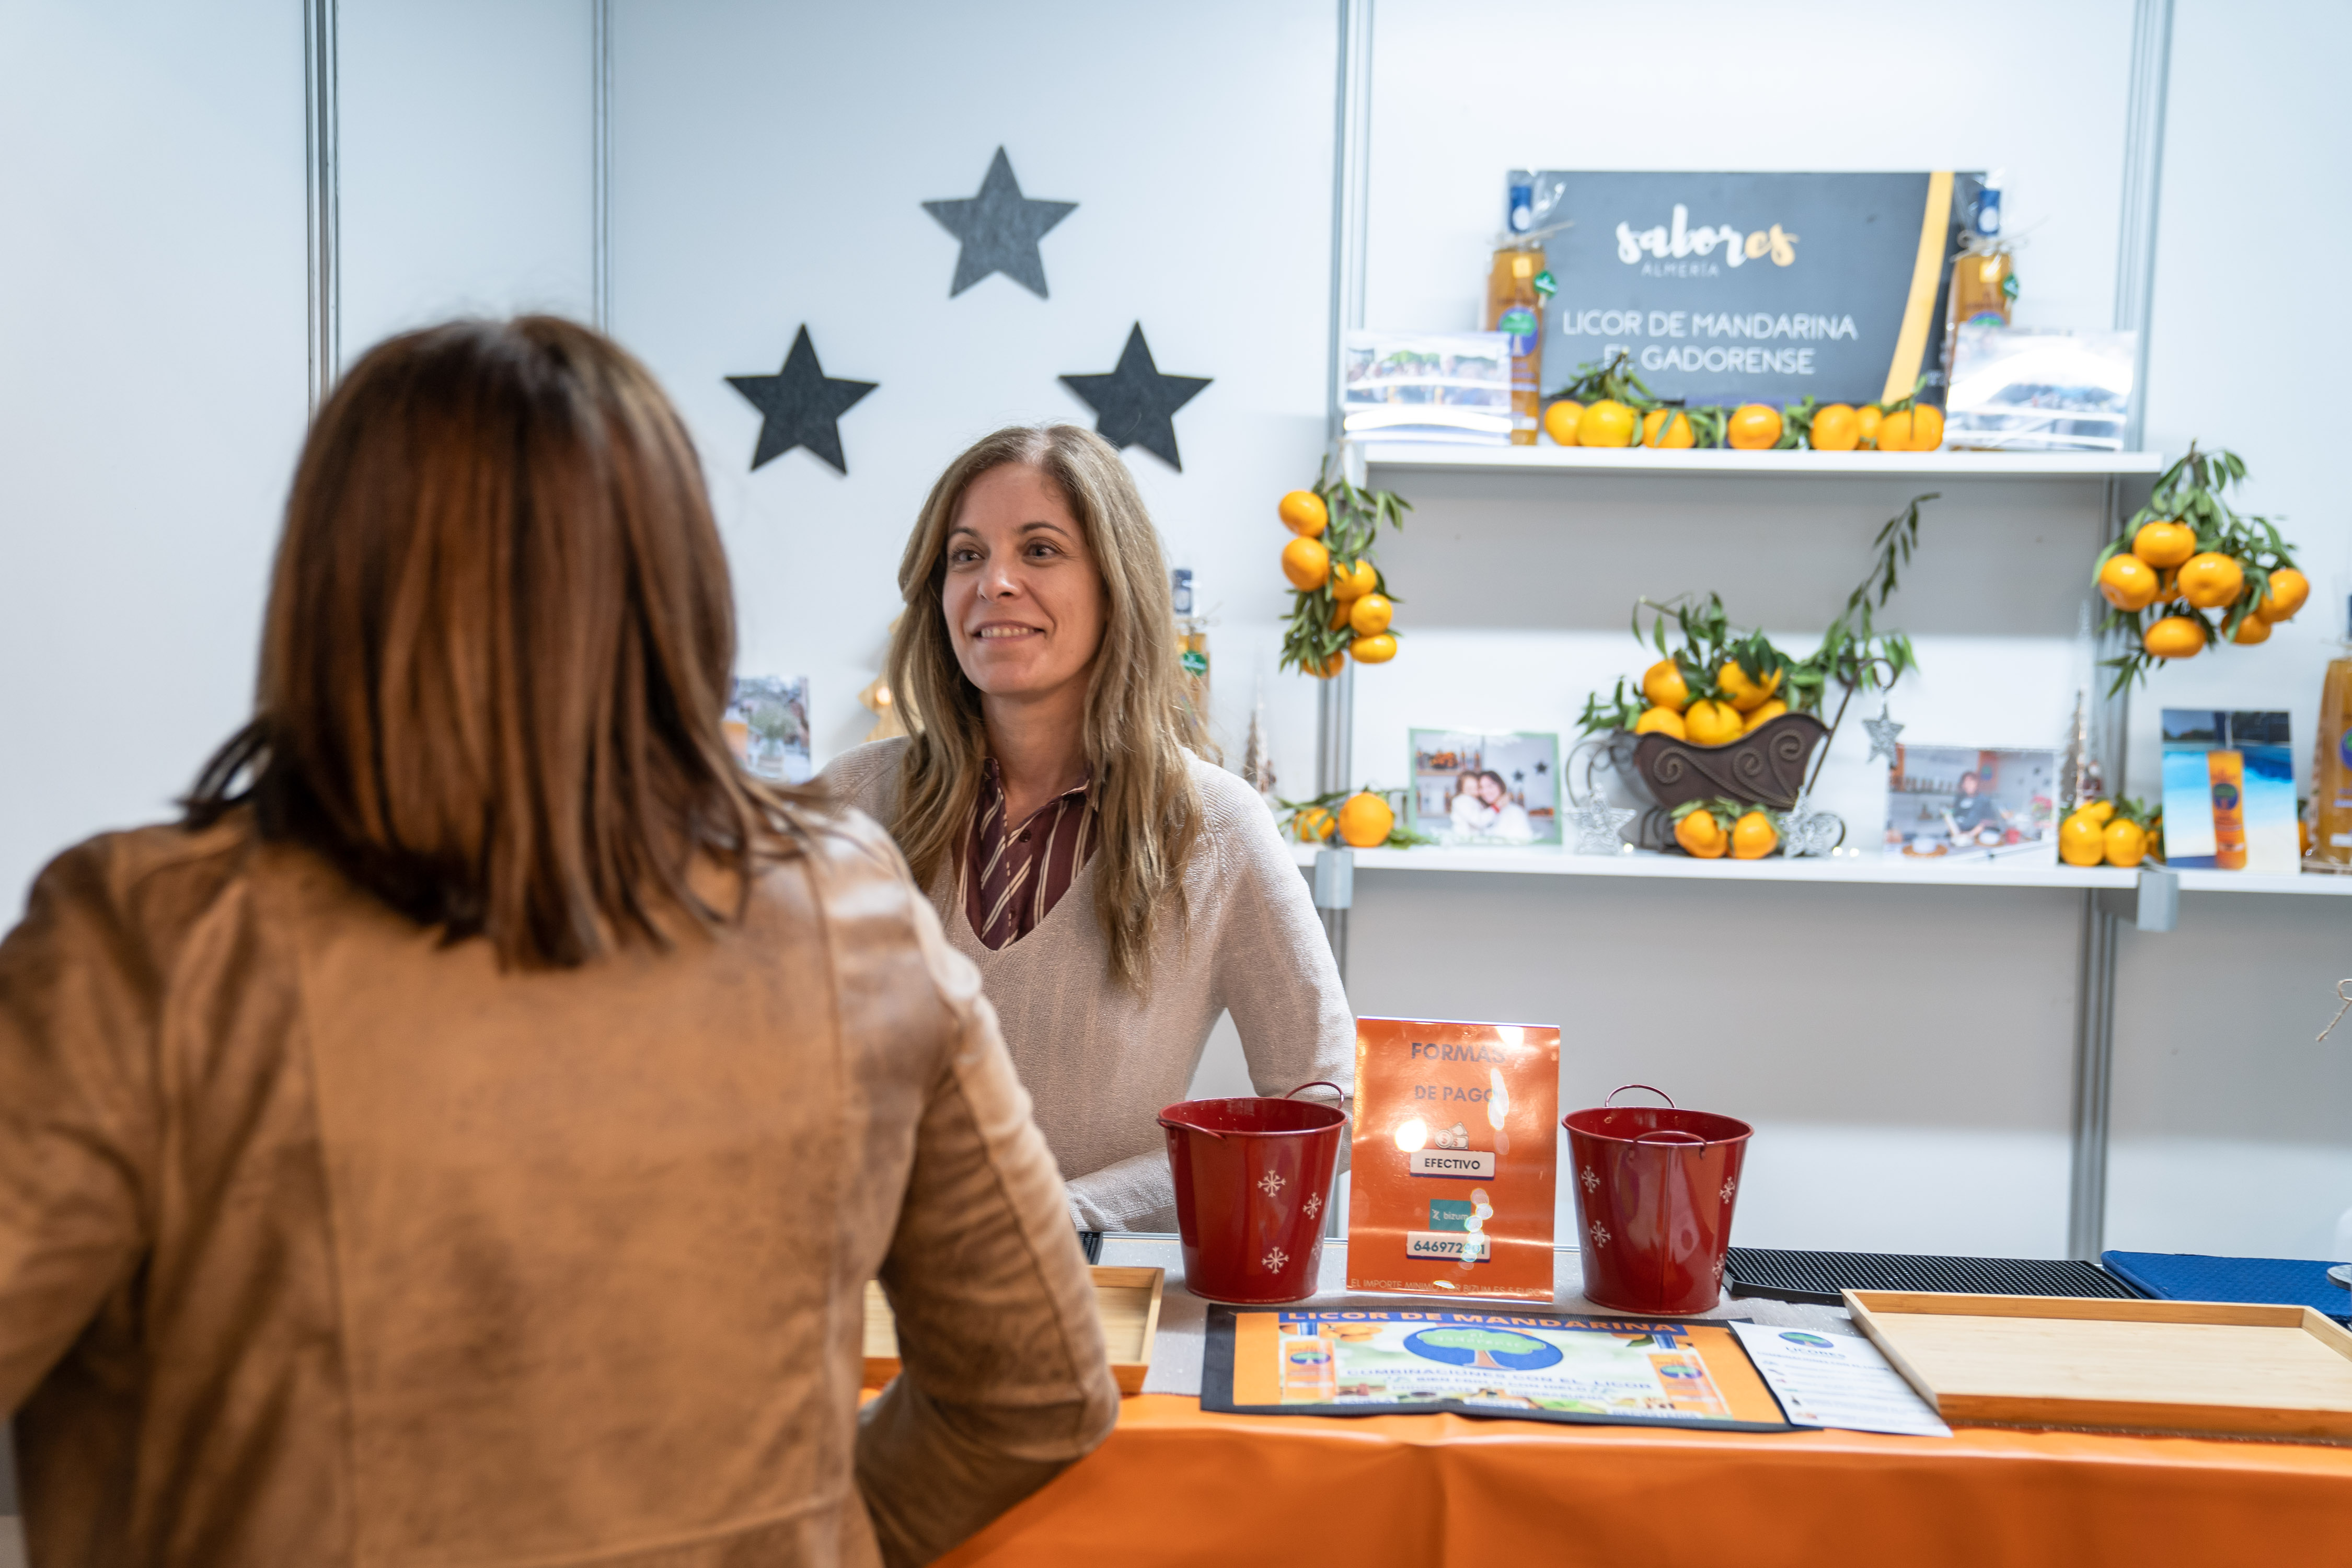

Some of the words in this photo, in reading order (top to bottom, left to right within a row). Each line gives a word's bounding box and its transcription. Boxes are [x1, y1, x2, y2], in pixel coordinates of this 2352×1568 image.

[1616, 203, 1800, 268] sabores
[1563, 308, 1643, 336] LICOR
[1647, 310, 1688, 338] DE
[1691, 312, 1860, 341] MANDARINA
[1640, 344, 1816, 375] GADORENSE
[1411, 1042, 1506, 1064] FORMAS
[1414, 1085, 1437, 1101] DE
[1425, 1158, 1480, 1170] EFECTIVO
[1443, 1211, 1469, 1220] bizum
[1351, 1278, 1361, 1287] EL
[1363, 1279, 1402, 1289] IMPORTE
[1463, 1284, 1492, 1293] BIZUM
[1288, 1312, 1390, 1320] LICOR
[1400, 1312, 1443, 1321] DE
[1453, 1313, 1678, 1332] MANDARINA
[1785, 1346, 1846, 1359] LICORES
[1594, 1380, 1652, 1390] LICOR
